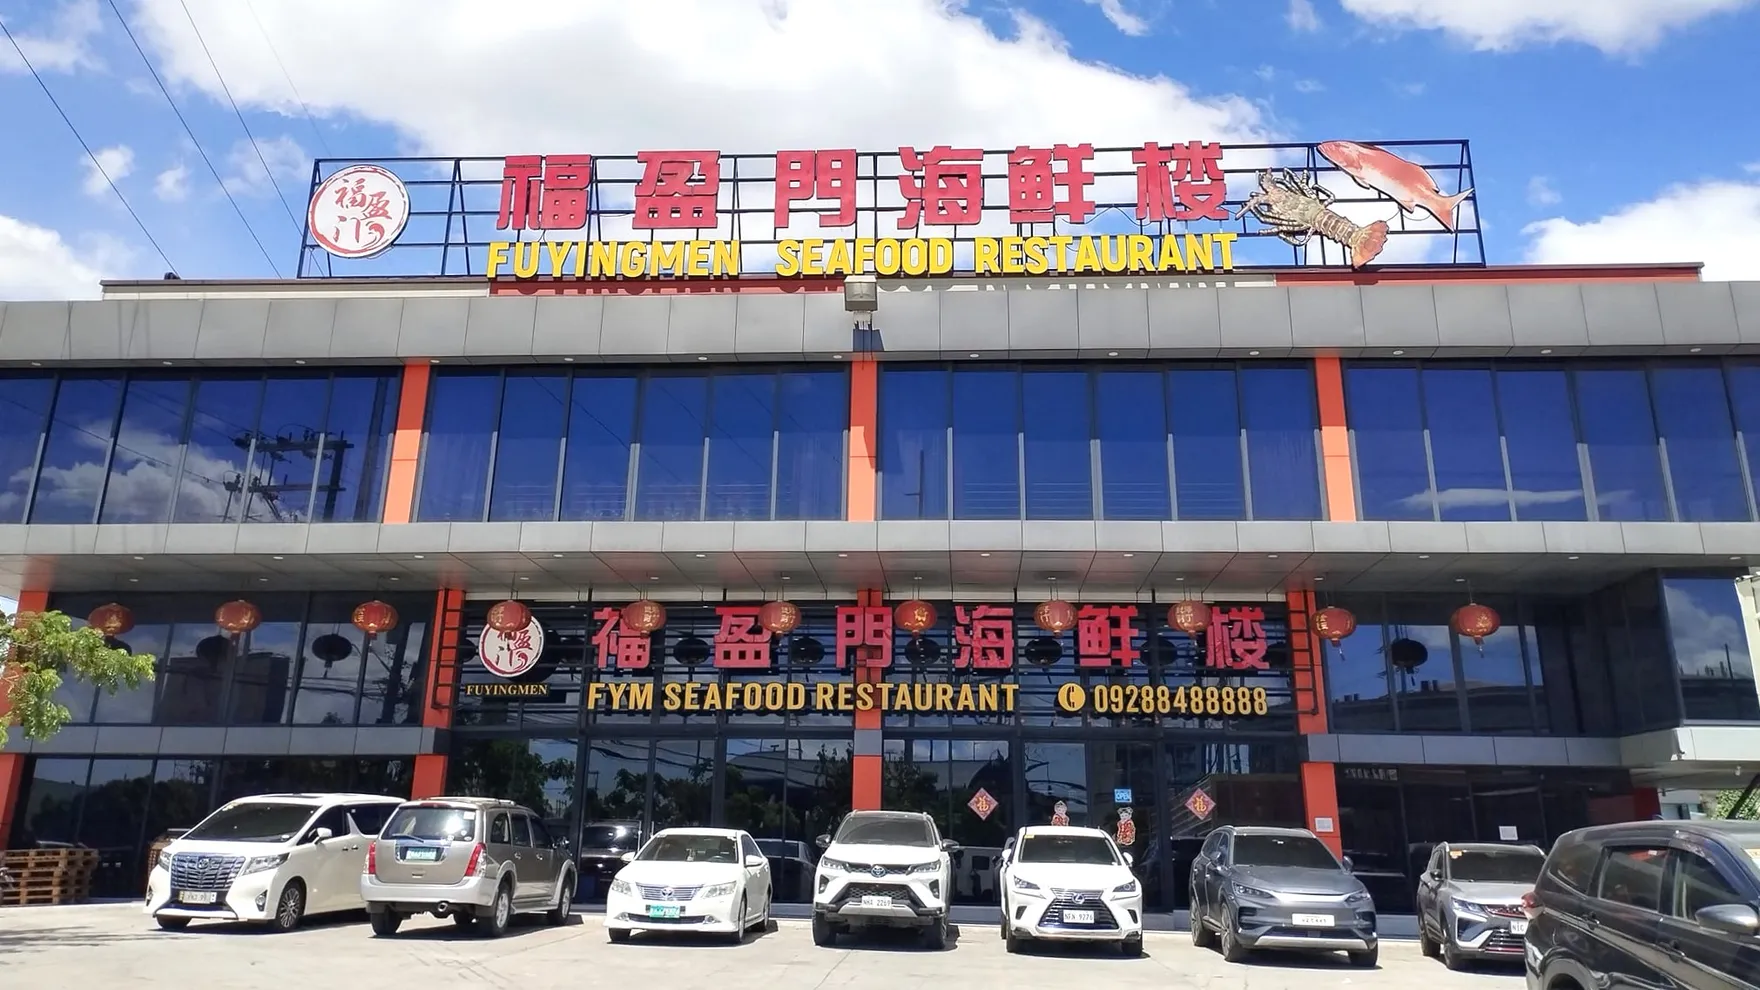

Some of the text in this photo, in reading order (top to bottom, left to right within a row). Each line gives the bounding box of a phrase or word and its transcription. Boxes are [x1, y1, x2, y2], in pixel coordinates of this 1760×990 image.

[486, 232, 1238, 279] FUYINGMEN SEAFOOD RESTAURANT
[466, 684, 547, 696] FUYINGMEN
[588, 682, 1268, 715] FYM SEAFOOD RESTAURANT 09288488888
